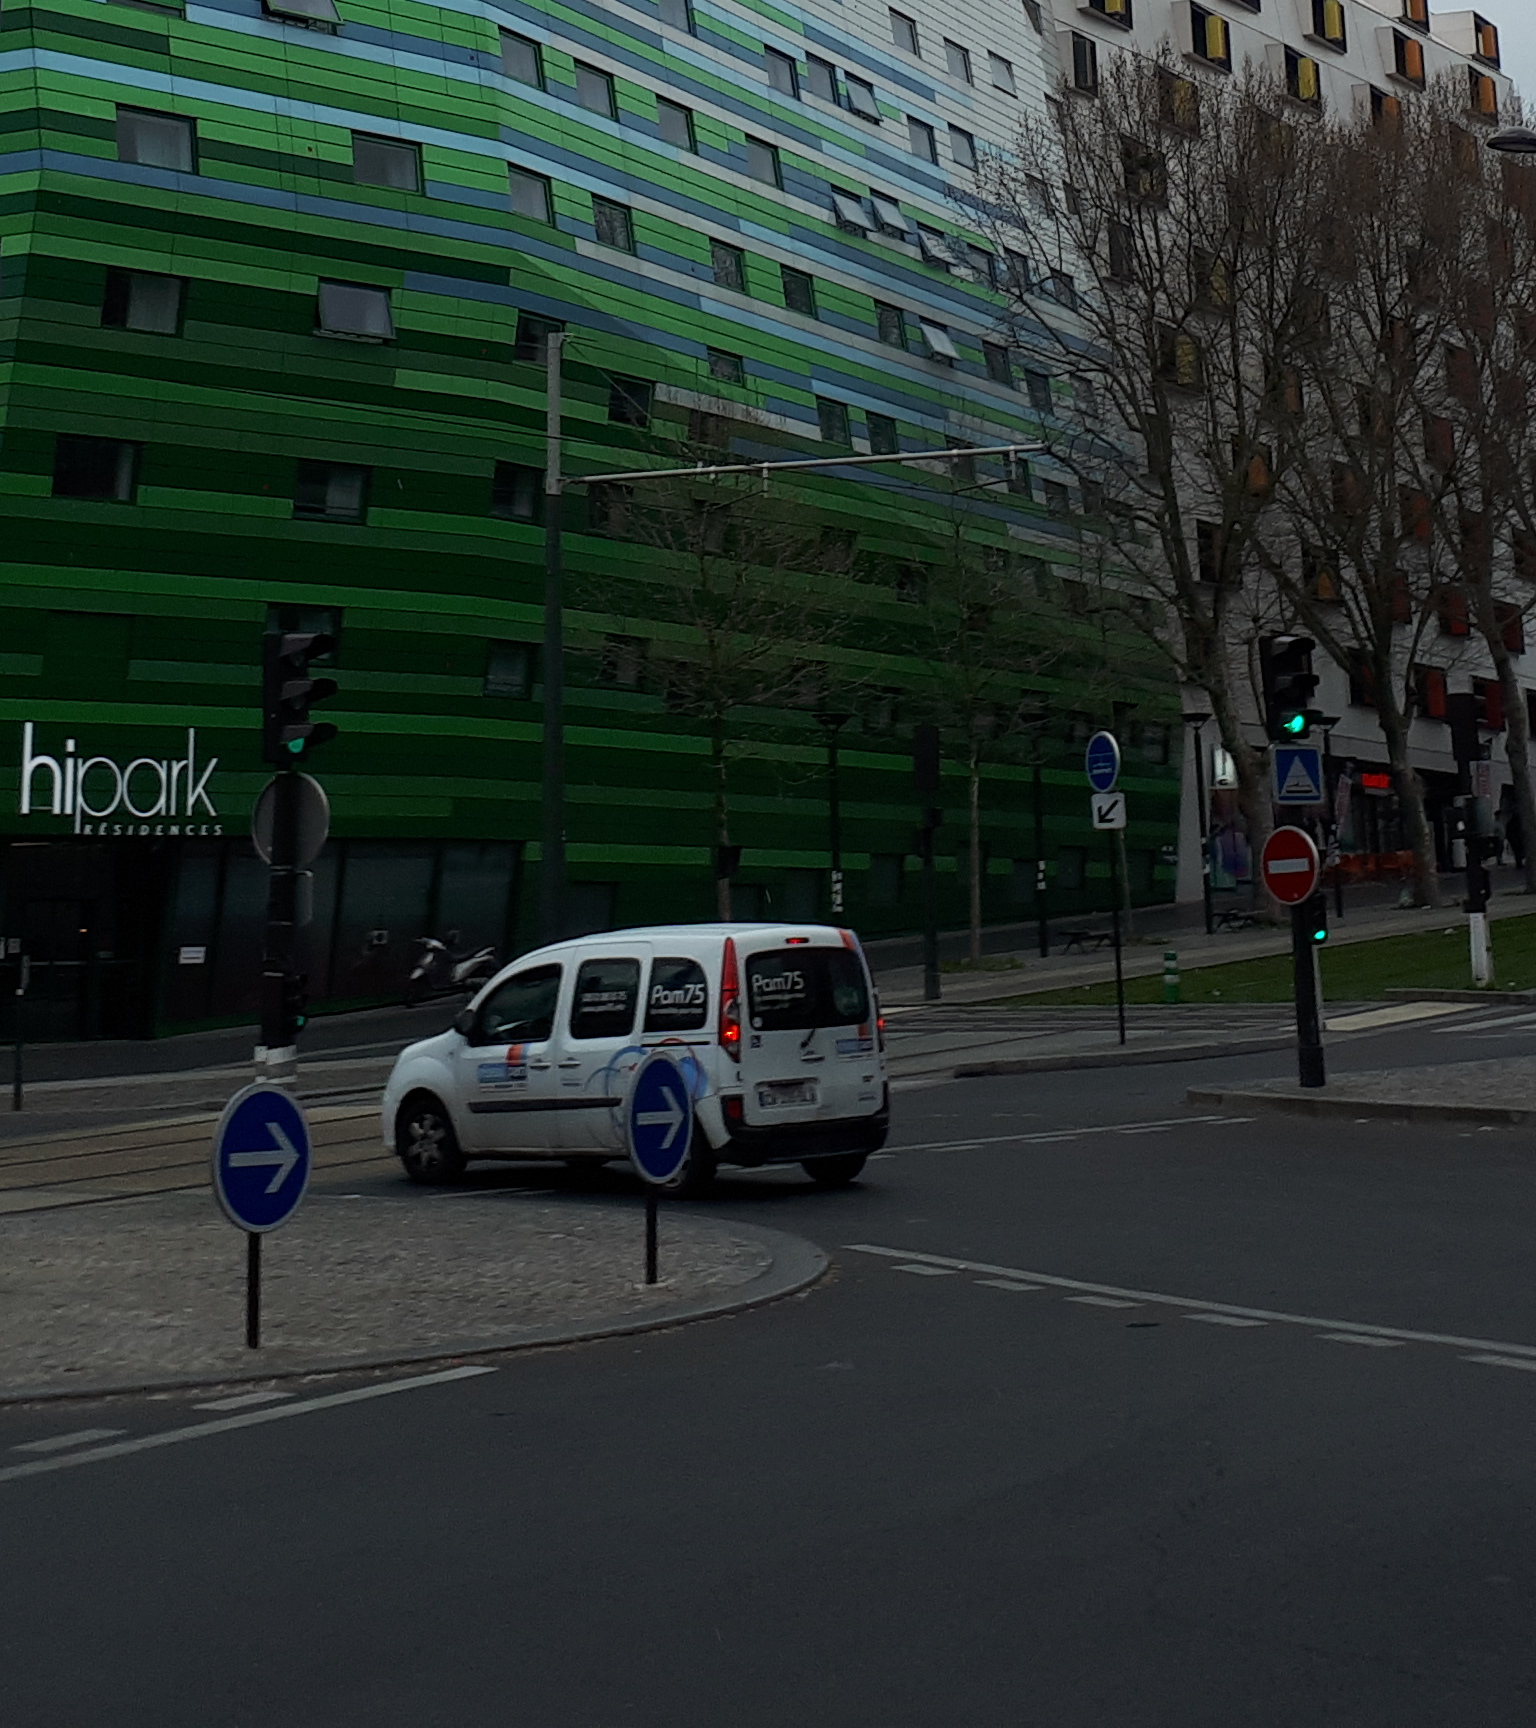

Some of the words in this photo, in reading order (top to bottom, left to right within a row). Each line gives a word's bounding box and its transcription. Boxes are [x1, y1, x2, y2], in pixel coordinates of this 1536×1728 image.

[19, 721, 219, 835] hipark
[83, 821, 224, 837] RÉSIDENCES
[650, 983, 705, 1005] Pam75
